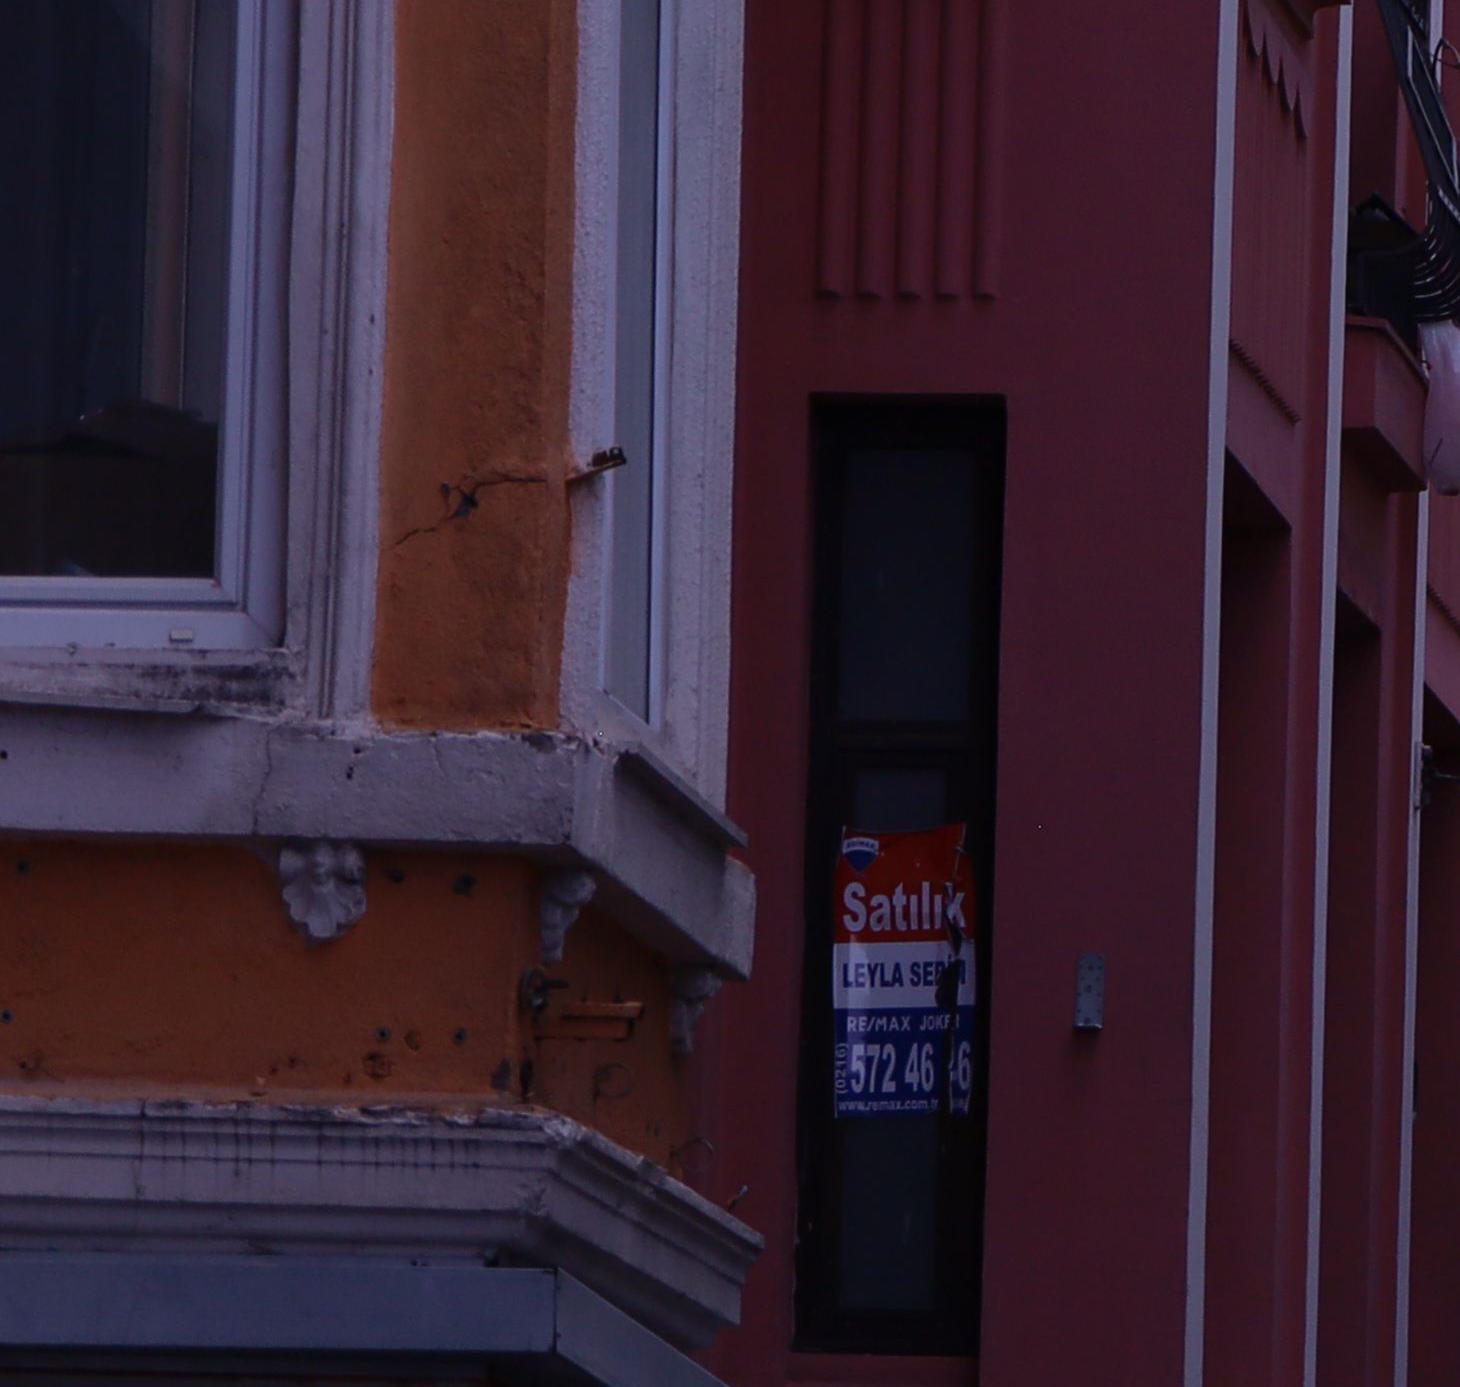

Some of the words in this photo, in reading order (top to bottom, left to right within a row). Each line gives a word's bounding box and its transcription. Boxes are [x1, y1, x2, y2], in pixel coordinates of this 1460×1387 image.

[842, 962, 904, 988] LEYLA
[847, 1015, 912, 1032] RE/MAX
[919, 1013, 960, 1031] JOKE
[850, 1042, 897, 1094] 572
[904, 1042, 935, 1093] 46
